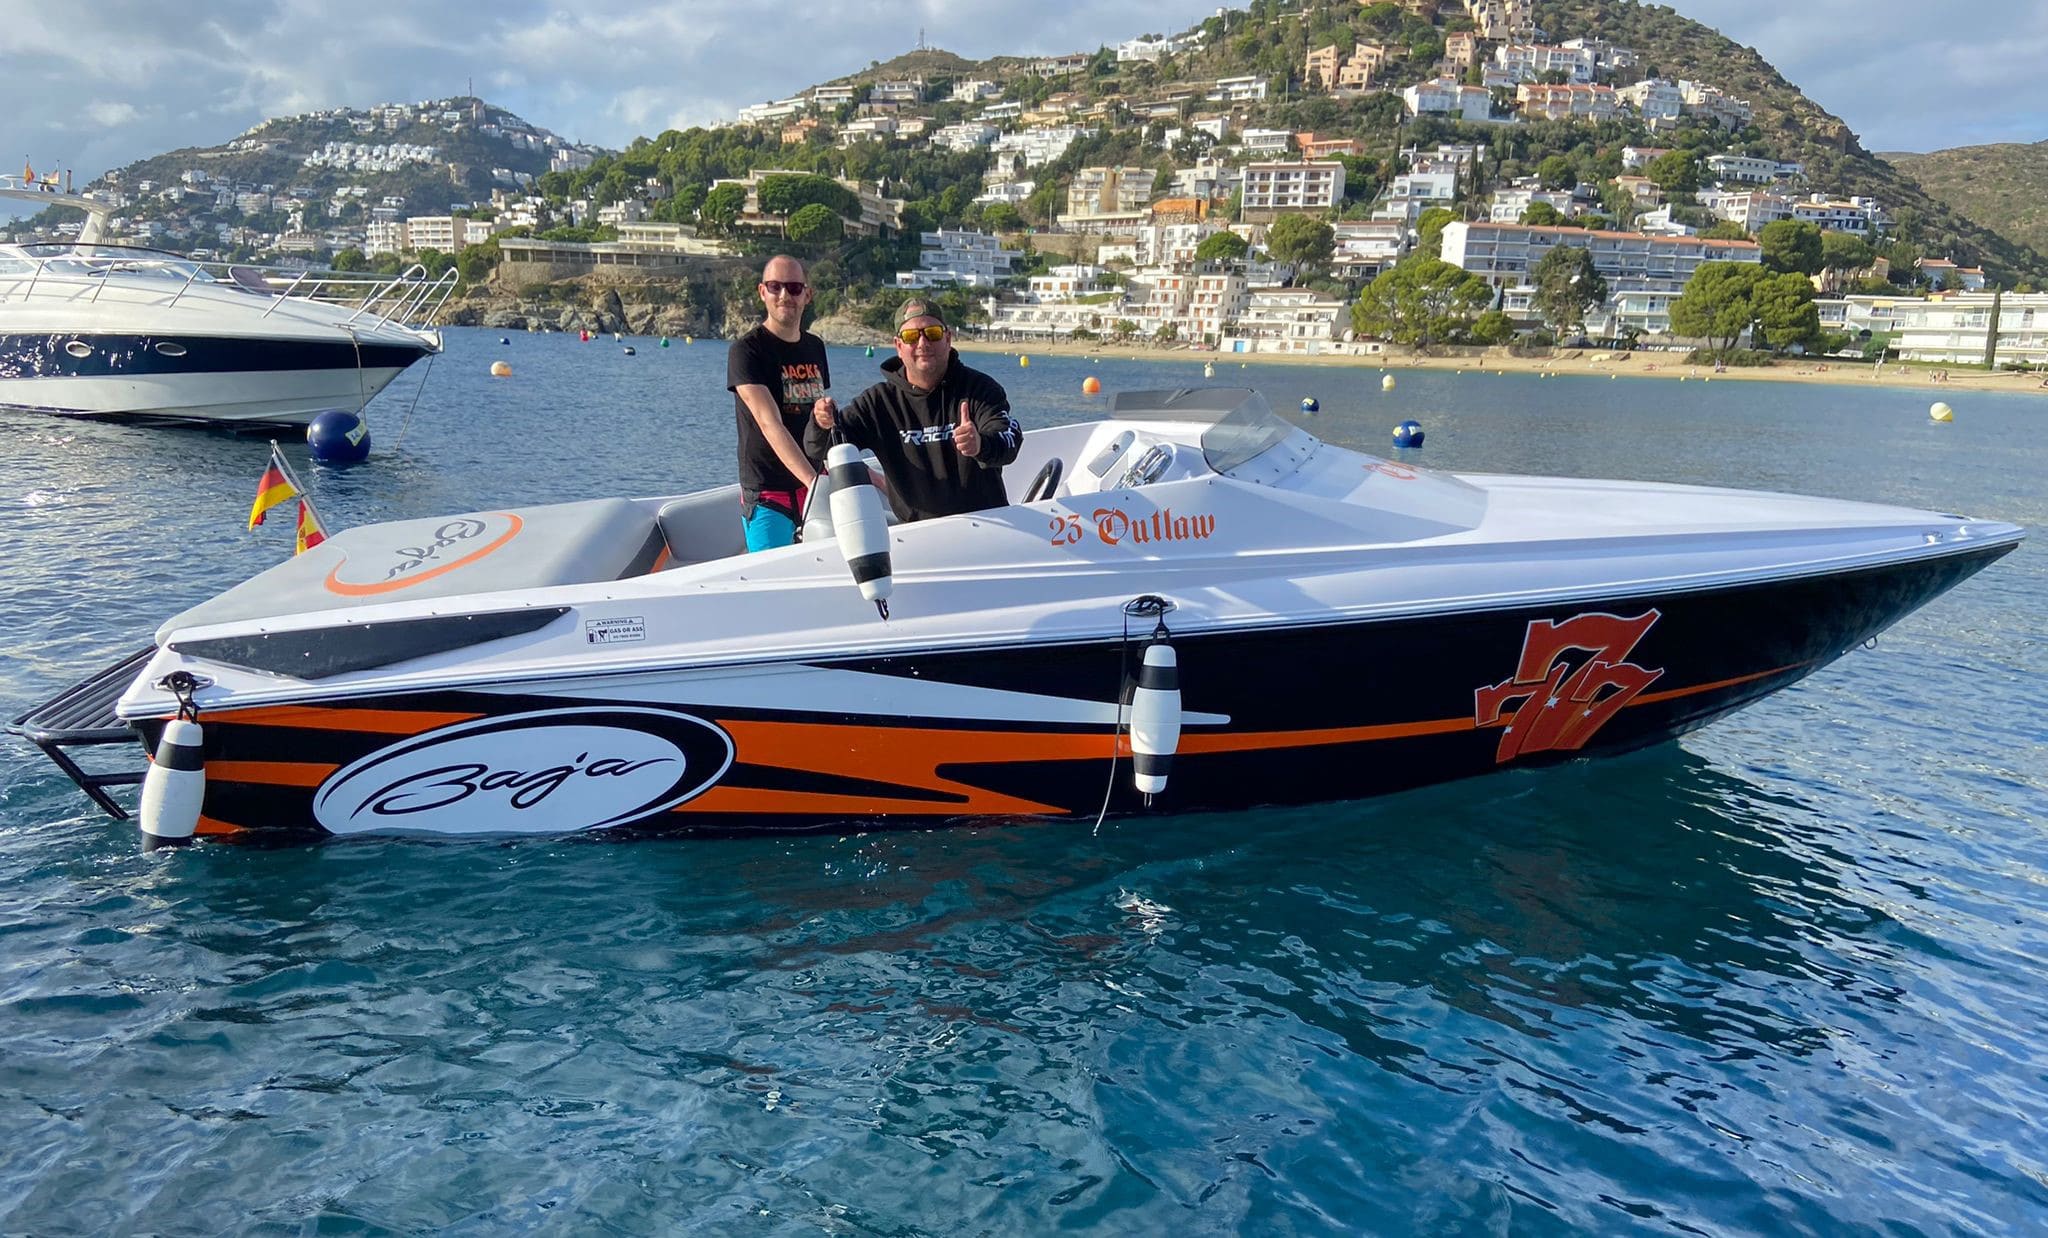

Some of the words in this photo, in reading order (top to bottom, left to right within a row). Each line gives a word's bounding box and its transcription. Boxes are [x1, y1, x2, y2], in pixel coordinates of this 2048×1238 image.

[784, 383, 825, 399] JONES
[385, 518, 487, 581] Baja
[1049, 513, 1083, 546] 23
[1093, 507, 1216, 545] Outlaw
[349, 751, 677, 819] Baja
